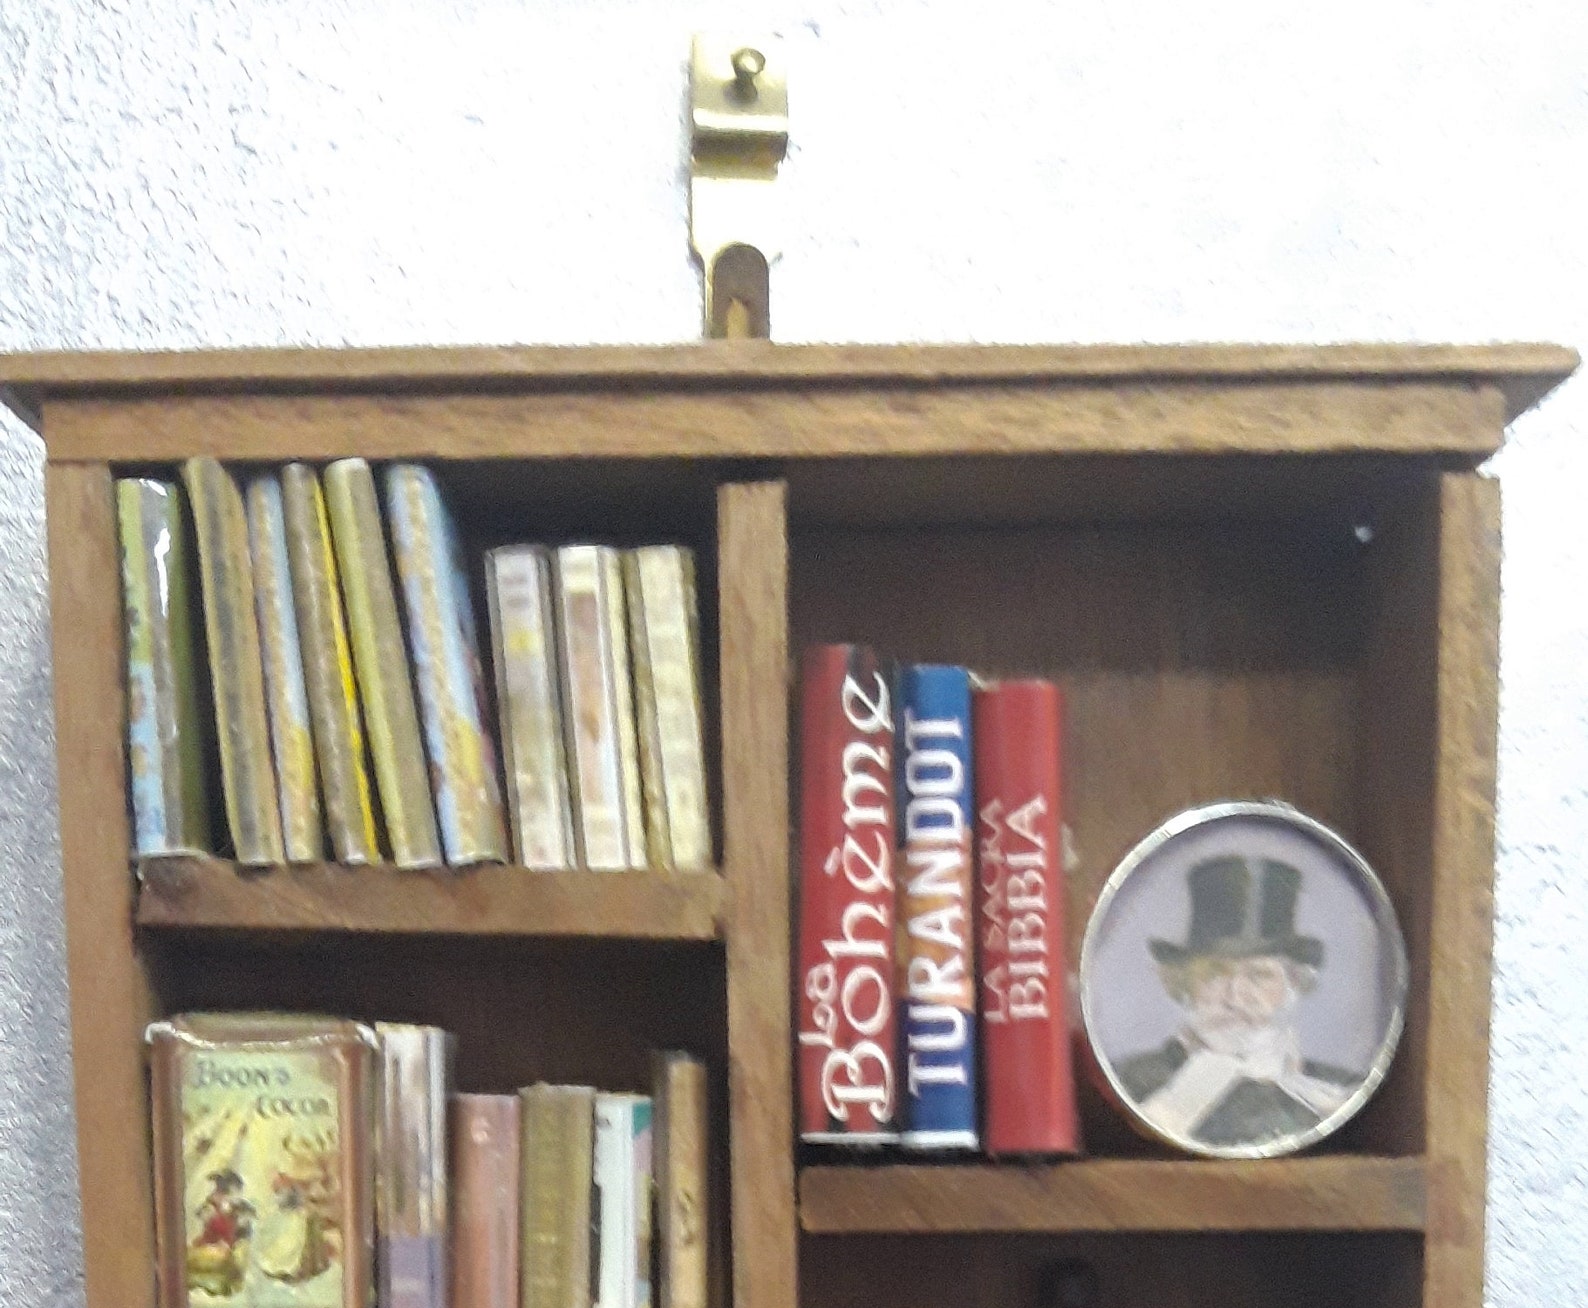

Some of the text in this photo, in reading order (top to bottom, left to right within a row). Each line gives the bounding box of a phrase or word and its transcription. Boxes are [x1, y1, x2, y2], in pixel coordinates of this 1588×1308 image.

[800, 962, 838, 1047] La
[820, 670, 895, 1123] Bohème
[904, 706, 969, 1097] TURANDOT
[984, 966, 1007, 1023] LA
[1005, 795, 1049, 1019] BIBBIA
